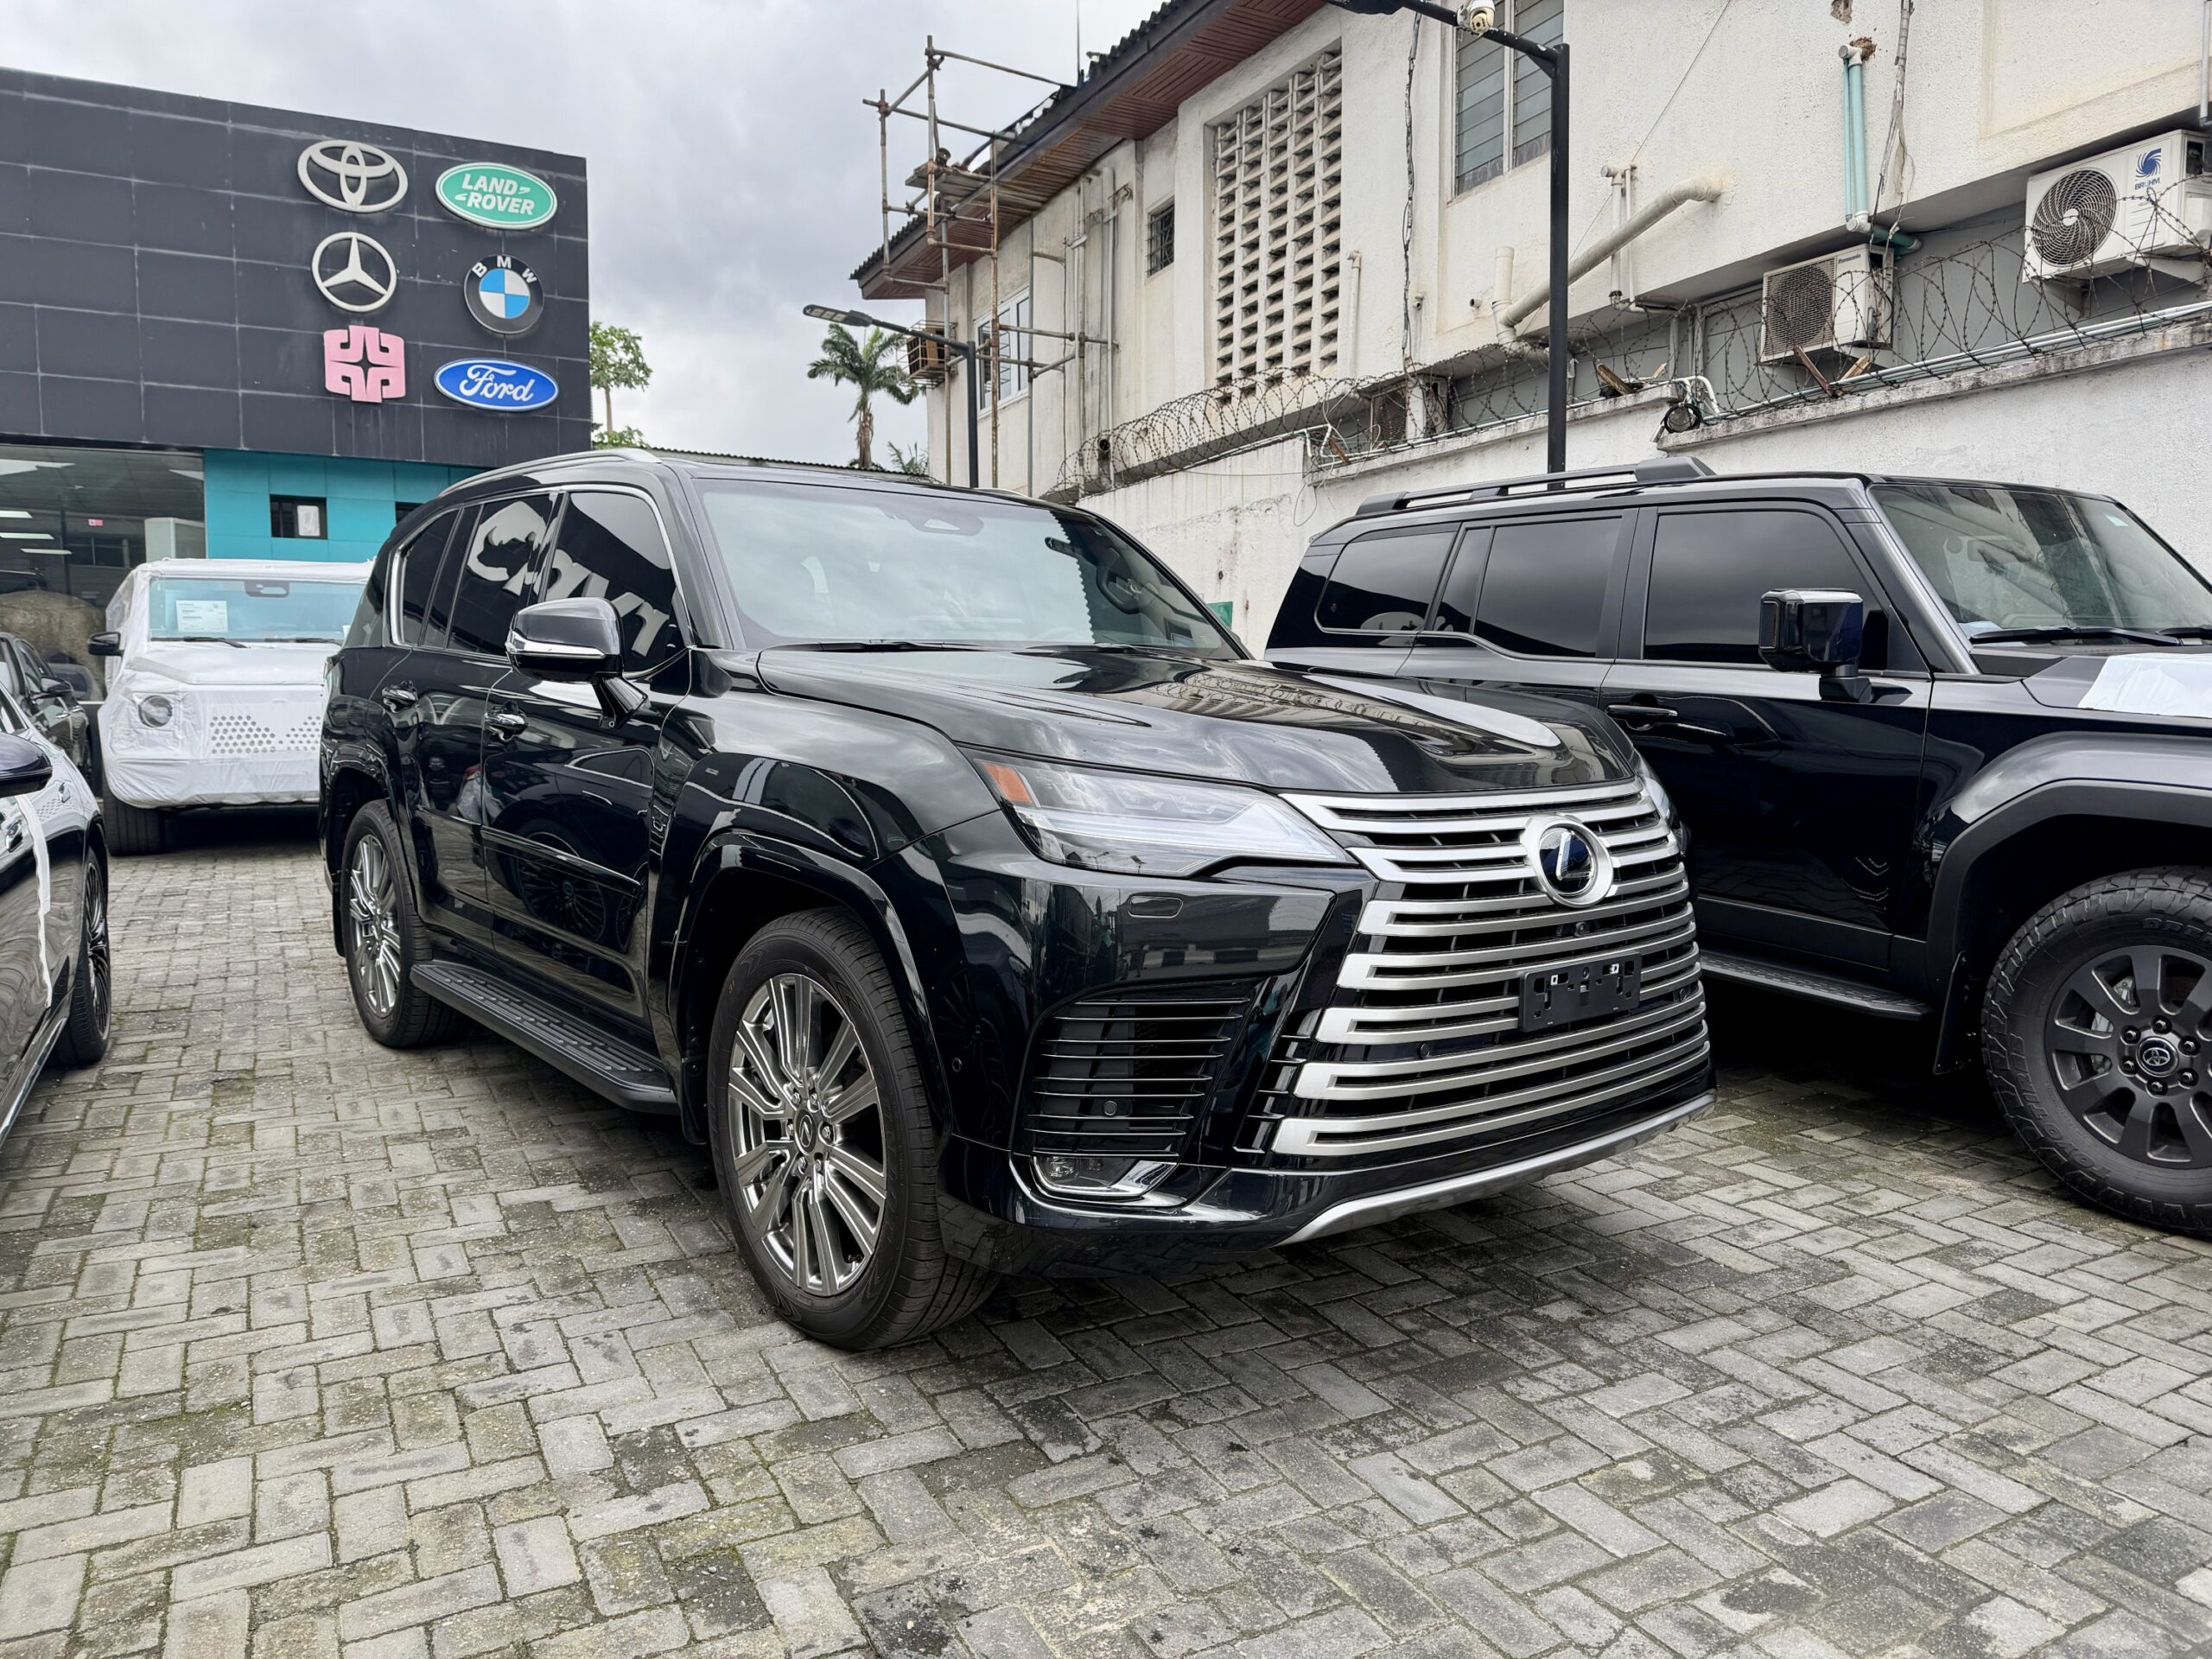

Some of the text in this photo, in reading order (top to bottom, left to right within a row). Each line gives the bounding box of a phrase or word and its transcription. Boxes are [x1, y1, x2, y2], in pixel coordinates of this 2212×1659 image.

[461, 173, 518, 196] LAND
[467, 193, 536, 216] ROVER
[472, 255, 537, 284] BMW
[459, 364, 536, 402] Ford
